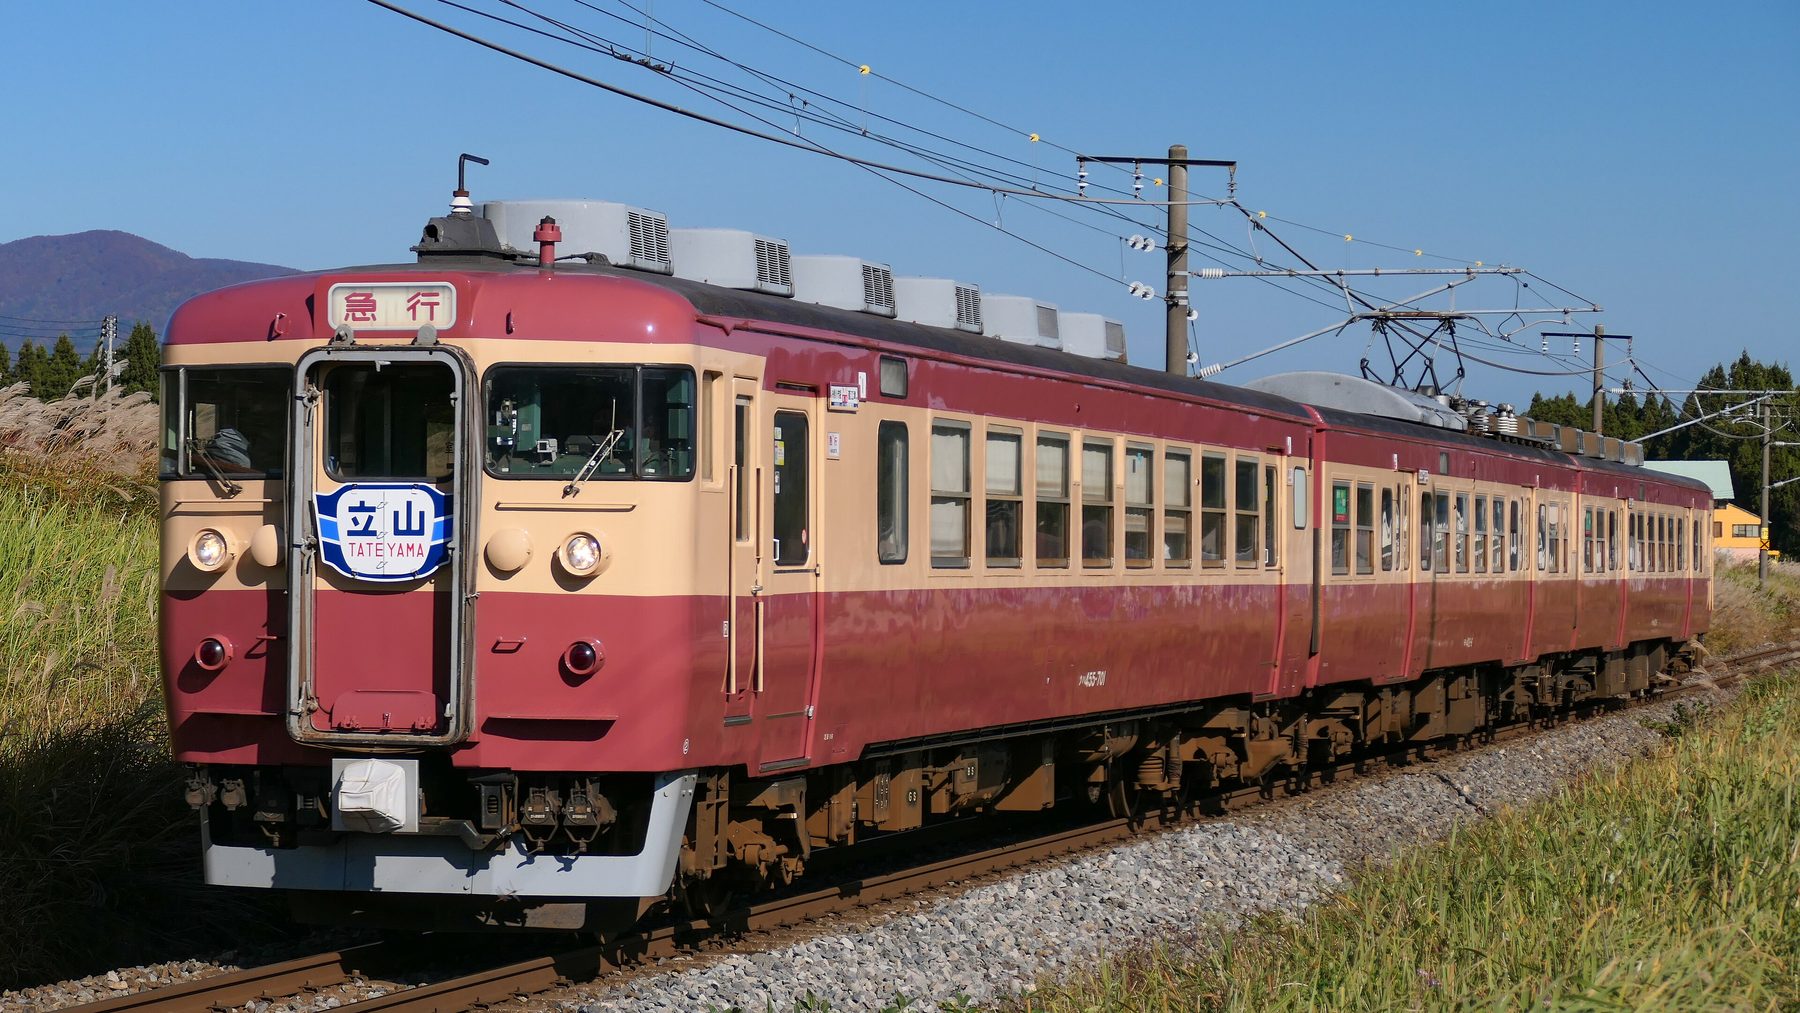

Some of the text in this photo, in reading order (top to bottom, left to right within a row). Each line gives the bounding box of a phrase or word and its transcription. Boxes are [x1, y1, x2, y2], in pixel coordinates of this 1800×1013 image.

[344, 292, 440, 322] 急行
[347, 500, 426, 537] 立山
[349, 542, 425, 558] TATEYAMA
